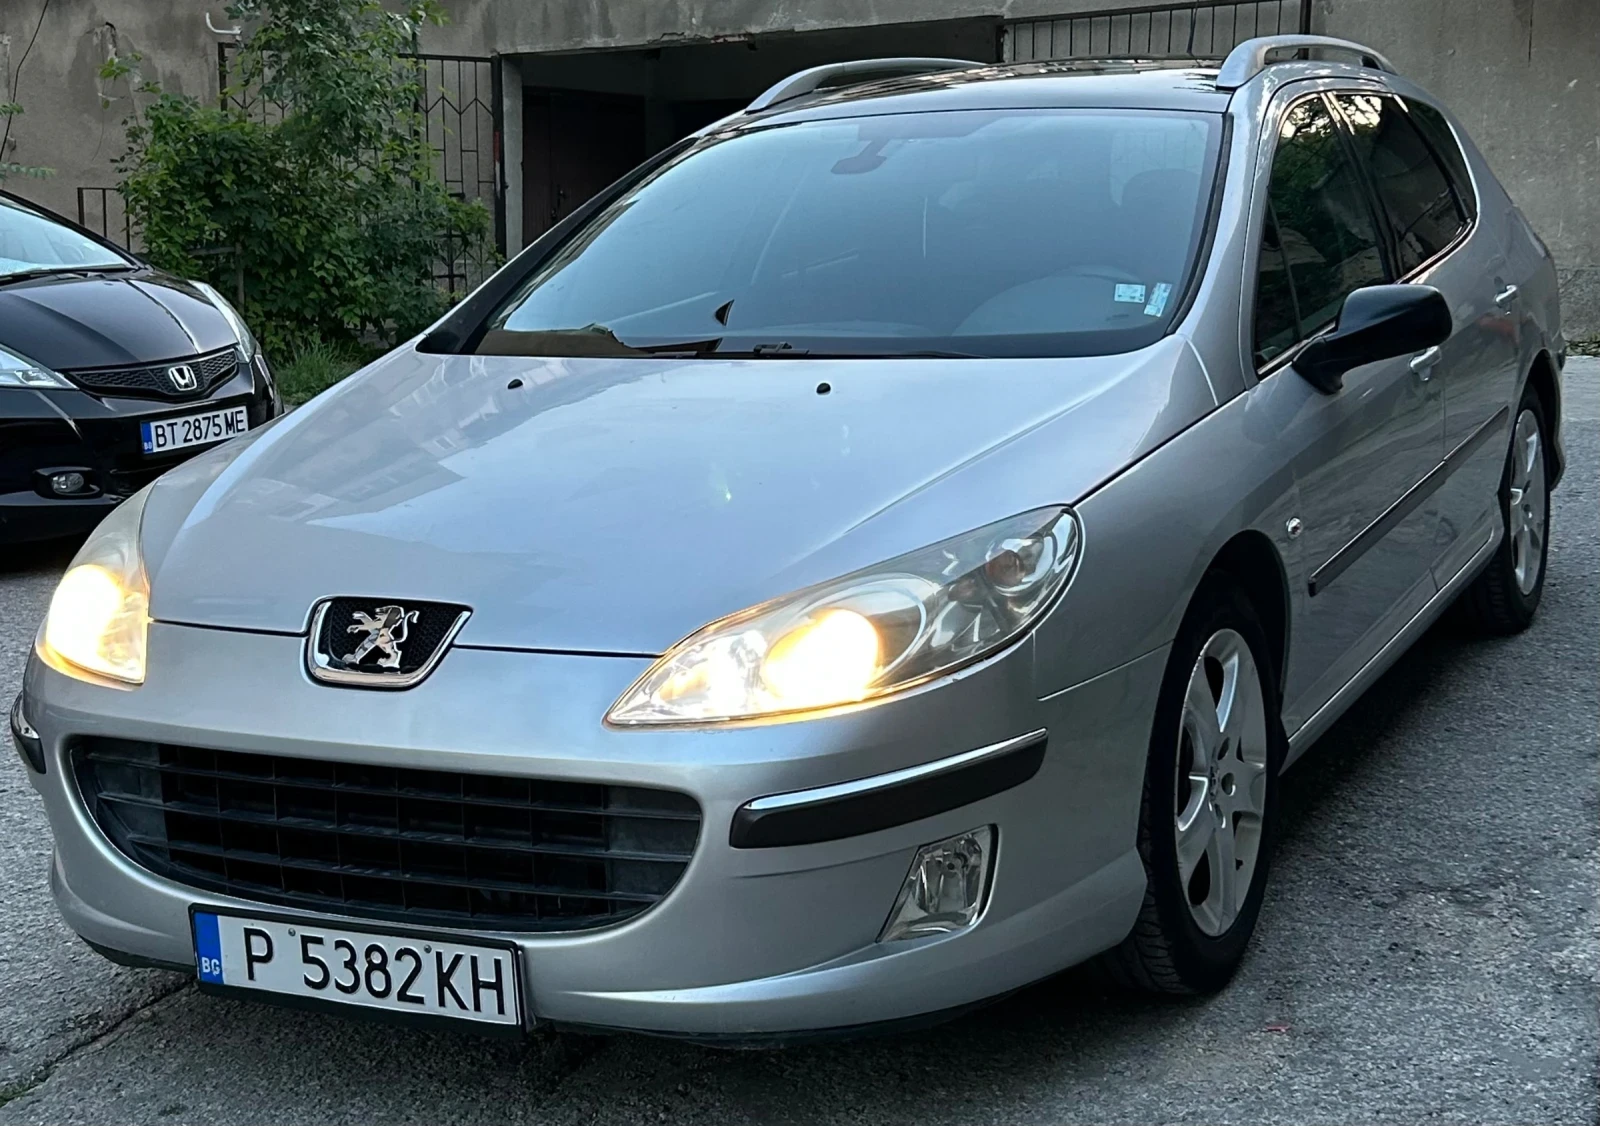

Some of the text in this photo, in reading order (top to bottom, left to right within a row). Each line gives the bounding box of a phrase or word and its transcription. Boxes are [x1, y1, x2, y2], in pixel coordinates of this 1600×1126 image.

[155, 410, 245, 448] BT 2875 ME
[201, 956, 221, 976] BG
[243, 926, 506, 1015] P 5382 KH
